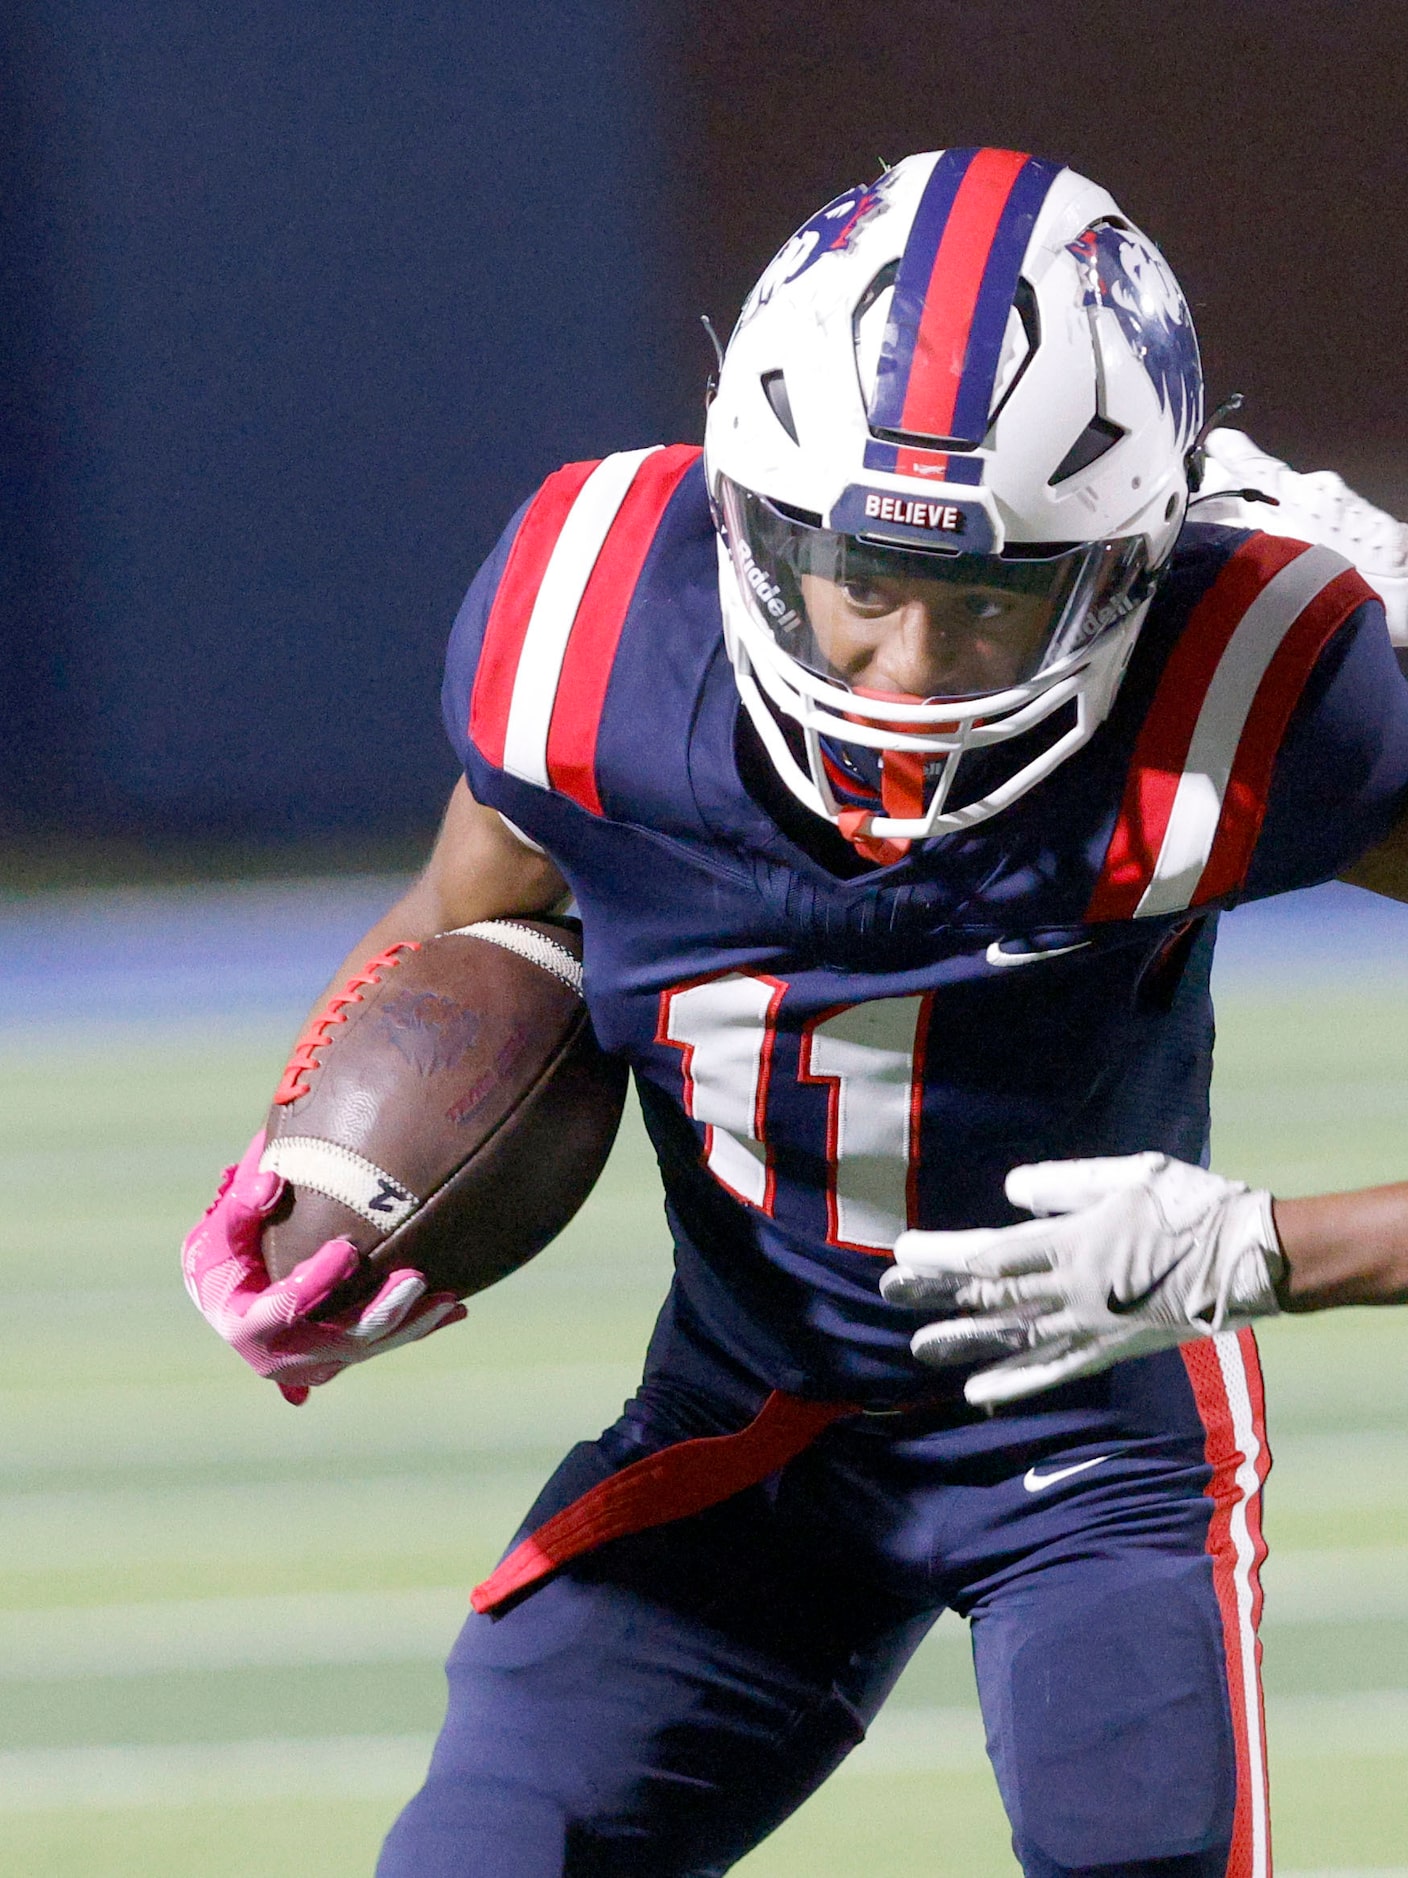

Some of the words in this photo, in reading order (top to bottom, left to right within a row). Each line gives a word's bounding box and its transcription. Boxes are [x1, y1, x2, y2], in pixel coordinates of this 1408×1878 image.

[864, 494, 961, 531] BELIEVE
[738, 538, 801, 633] Riddell
[653, 964, 936, 1258] 11
